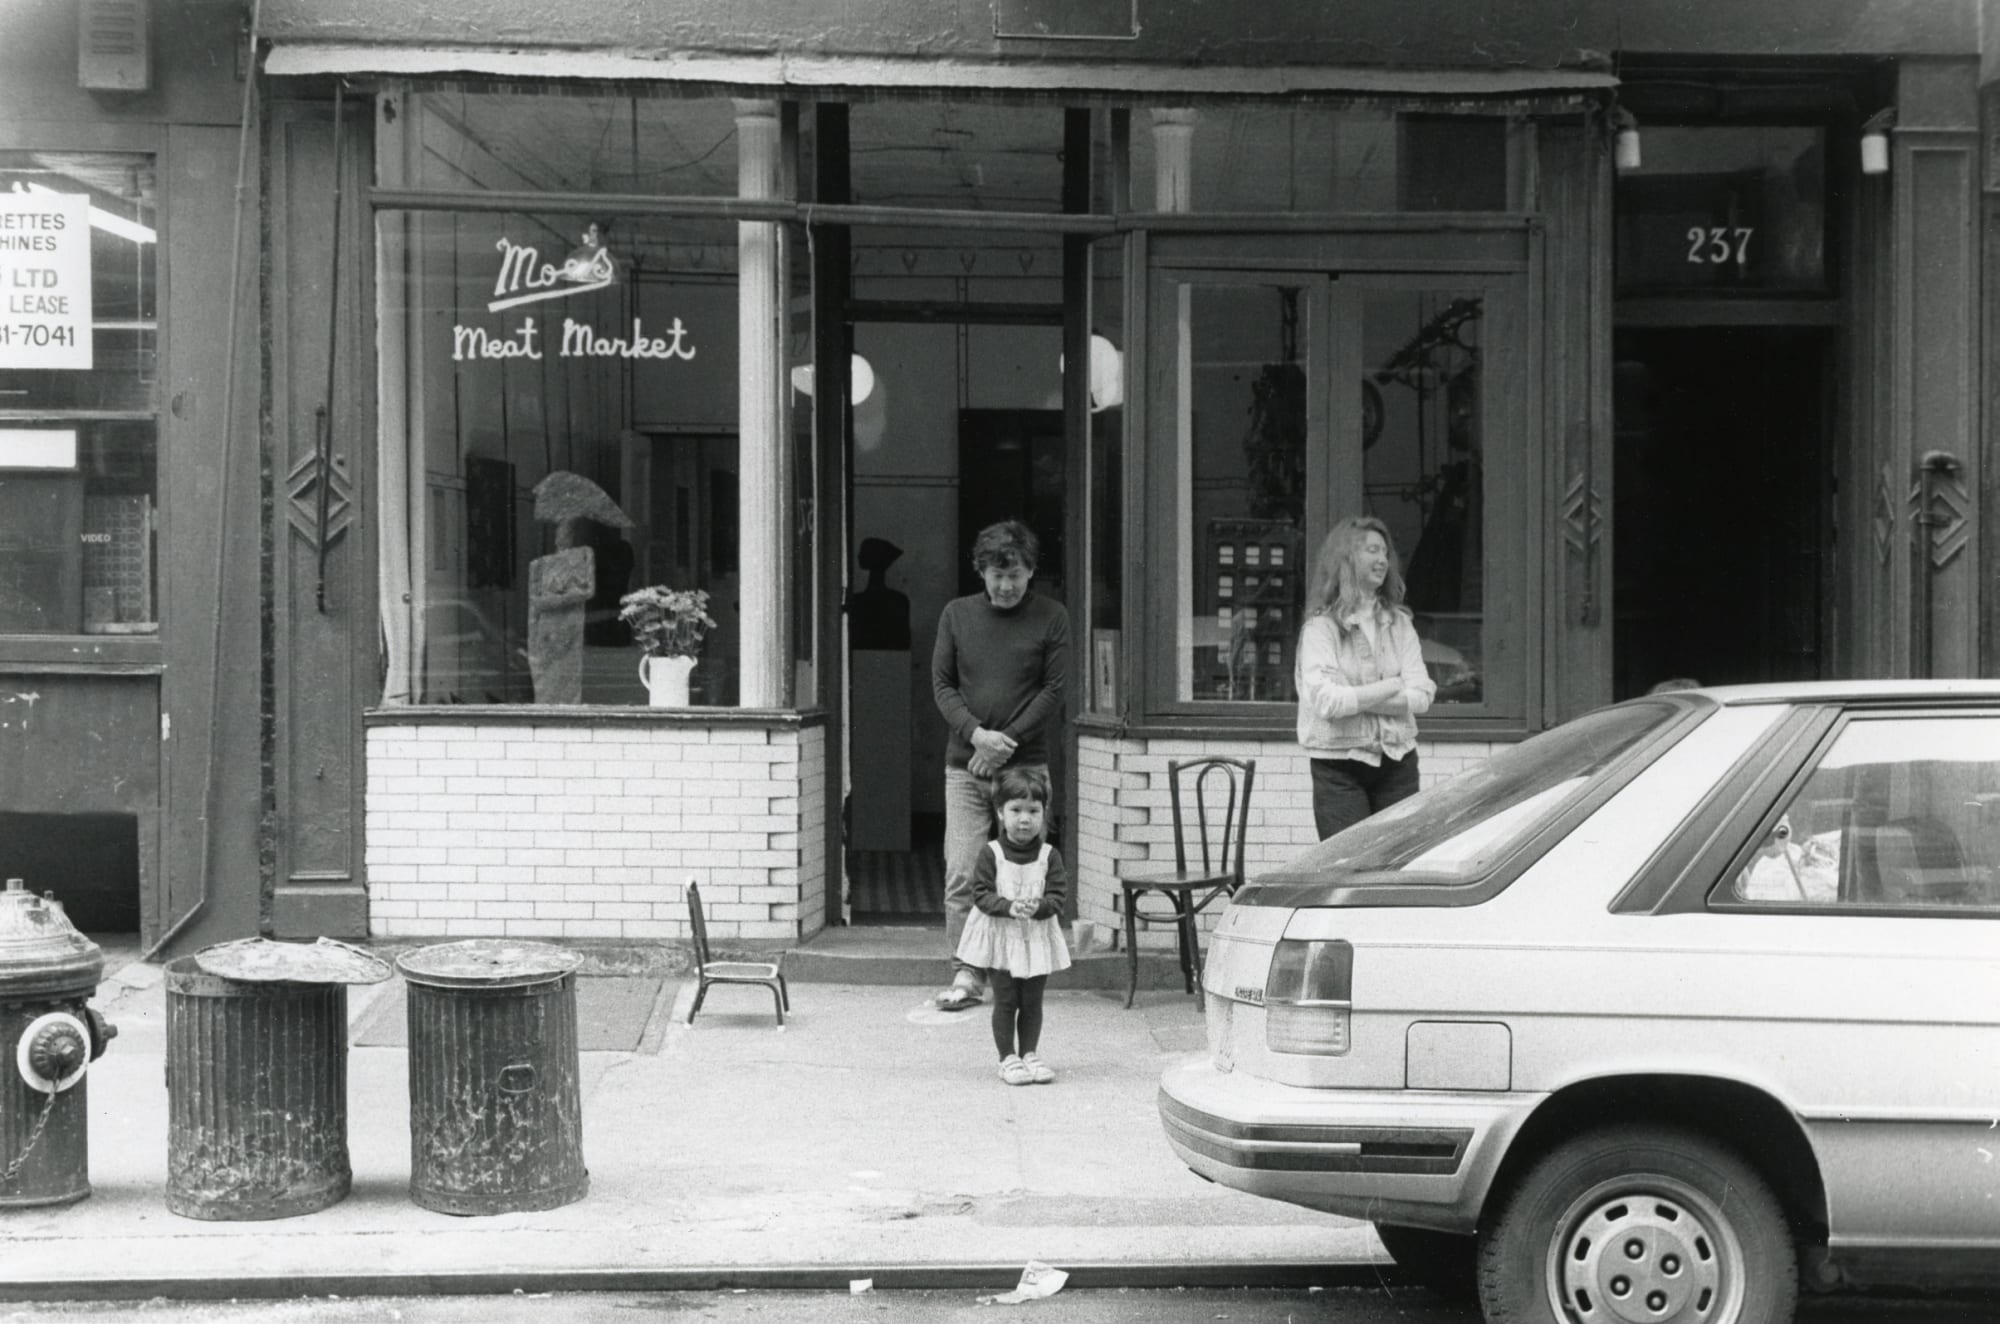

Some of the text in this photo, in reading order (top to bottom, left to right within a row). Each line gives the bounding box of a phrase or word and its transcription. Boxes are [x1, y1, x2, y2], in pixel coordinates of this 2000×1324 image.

[0, 213, 65, 230] ETTES
[1687, 227, 1754, 264] 237
[13, 269, 58, 288] LTD
[10, 295, 69, 315] LEASE
[0, 324, 75, 347] 1-7041
[452, 317, 696, 361] Meat Market
